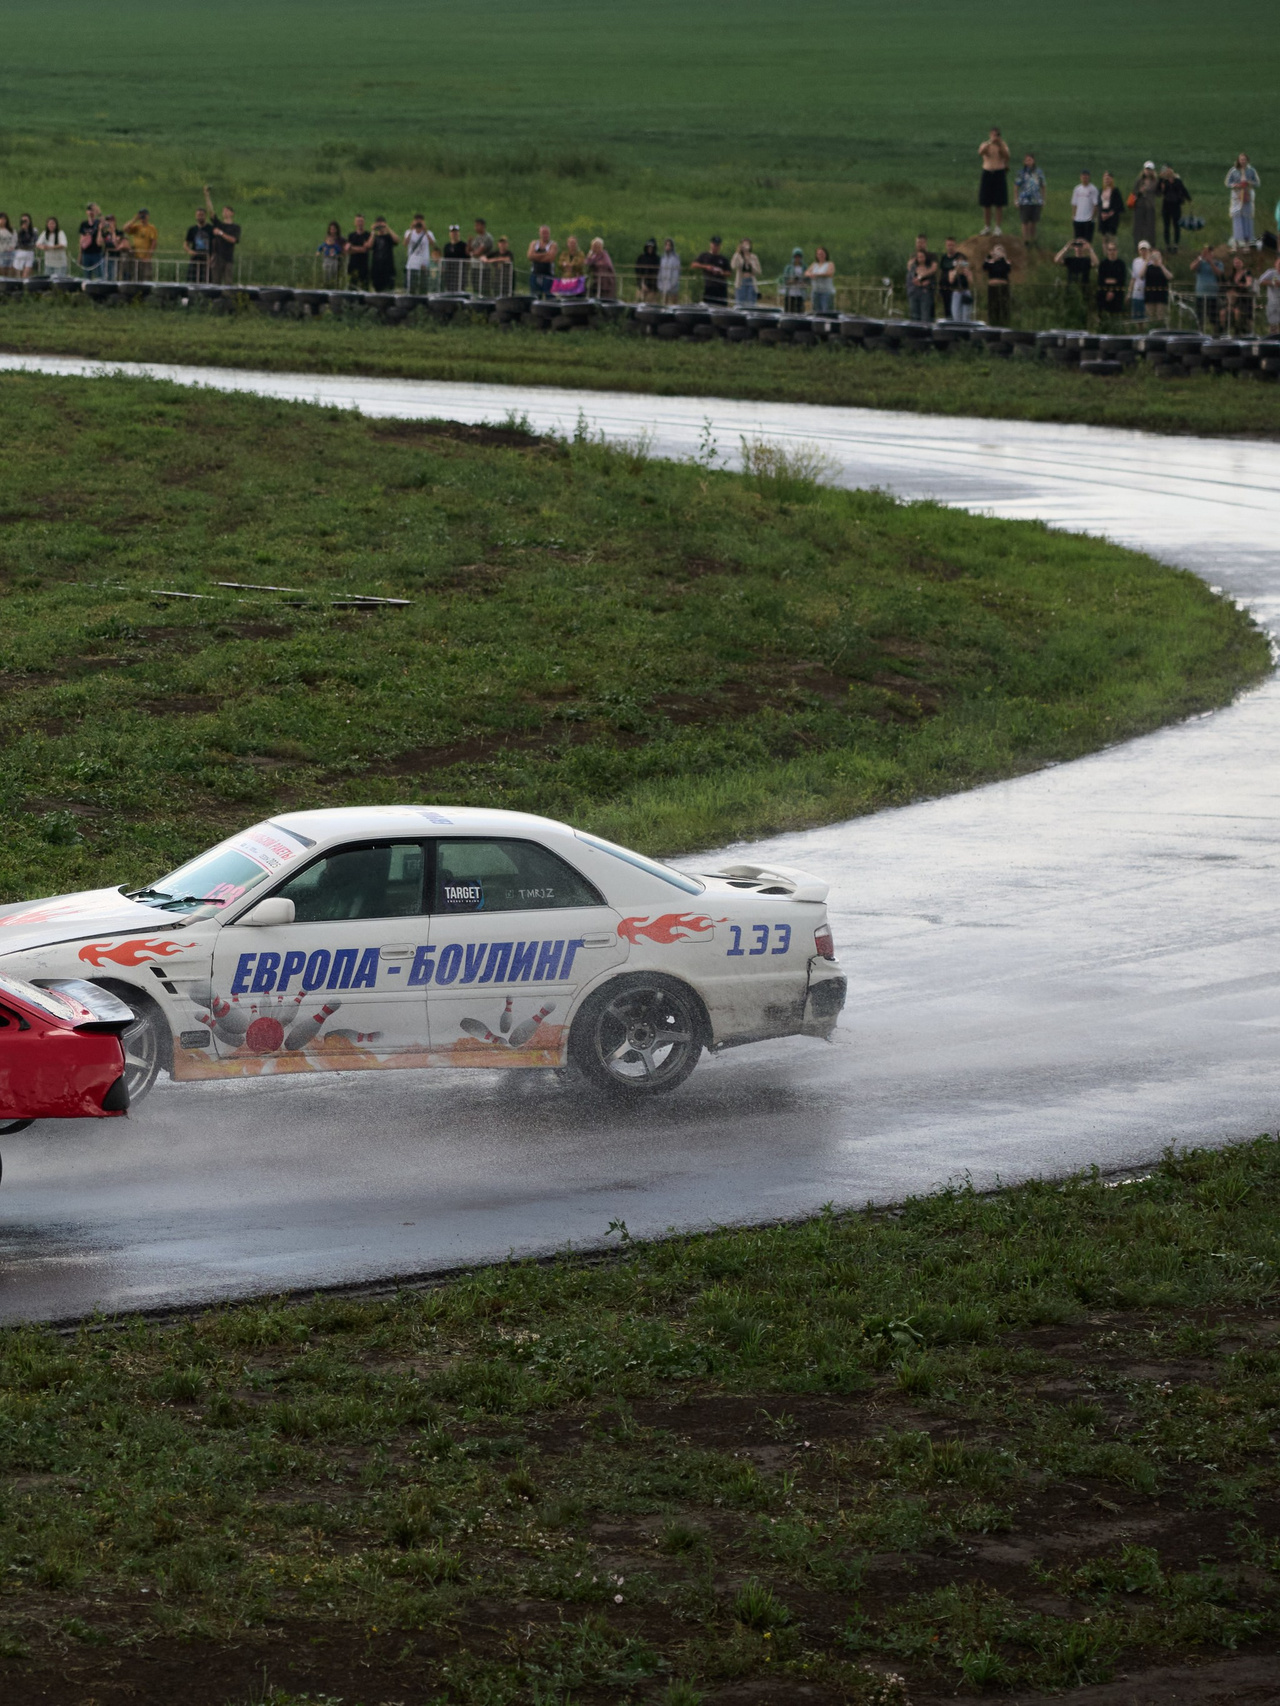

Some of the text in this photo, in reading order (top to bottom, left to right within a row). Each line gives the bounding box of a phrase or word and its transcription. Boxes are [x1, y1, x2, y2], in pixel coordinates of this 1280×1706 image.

[444, 887, 480, 899] TARGET
[726, 923, 792, 956] 133
[231, 948, 380, 994] ЕВРОПА
[407, 939, 586, 986] БОУЛИНГ
